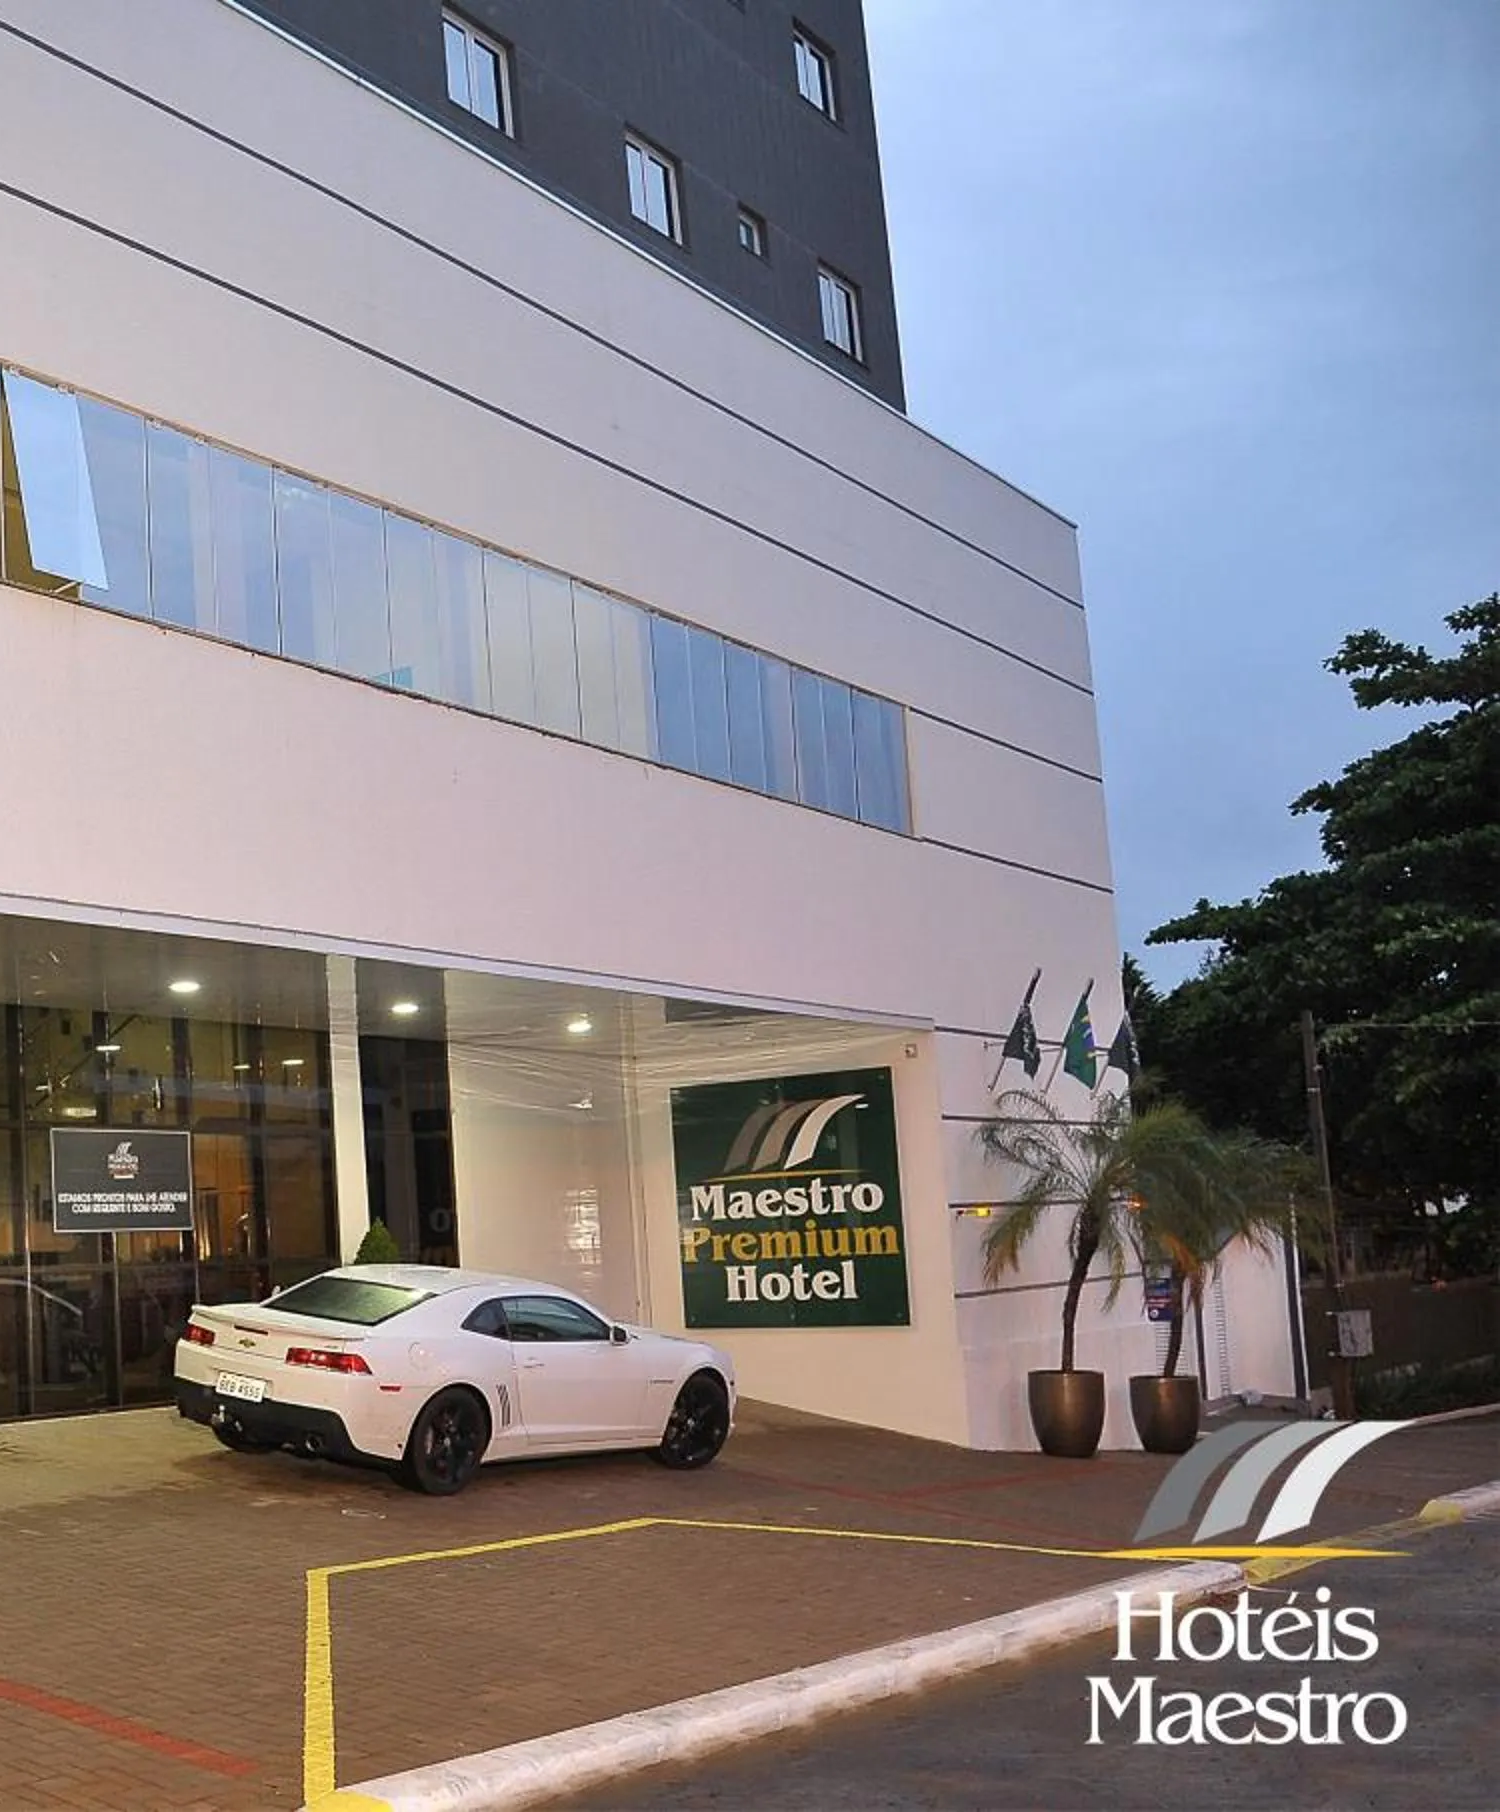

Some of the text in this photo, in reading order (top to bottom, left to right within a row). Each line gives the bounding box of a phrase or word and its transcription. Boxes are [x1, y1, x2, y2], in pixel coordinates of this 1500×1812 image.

[690, 1178, 884, 1221] Maestro
[682, 1220, 899, 1264] Premium
[726, 1260, 859, 1302] Hotel
